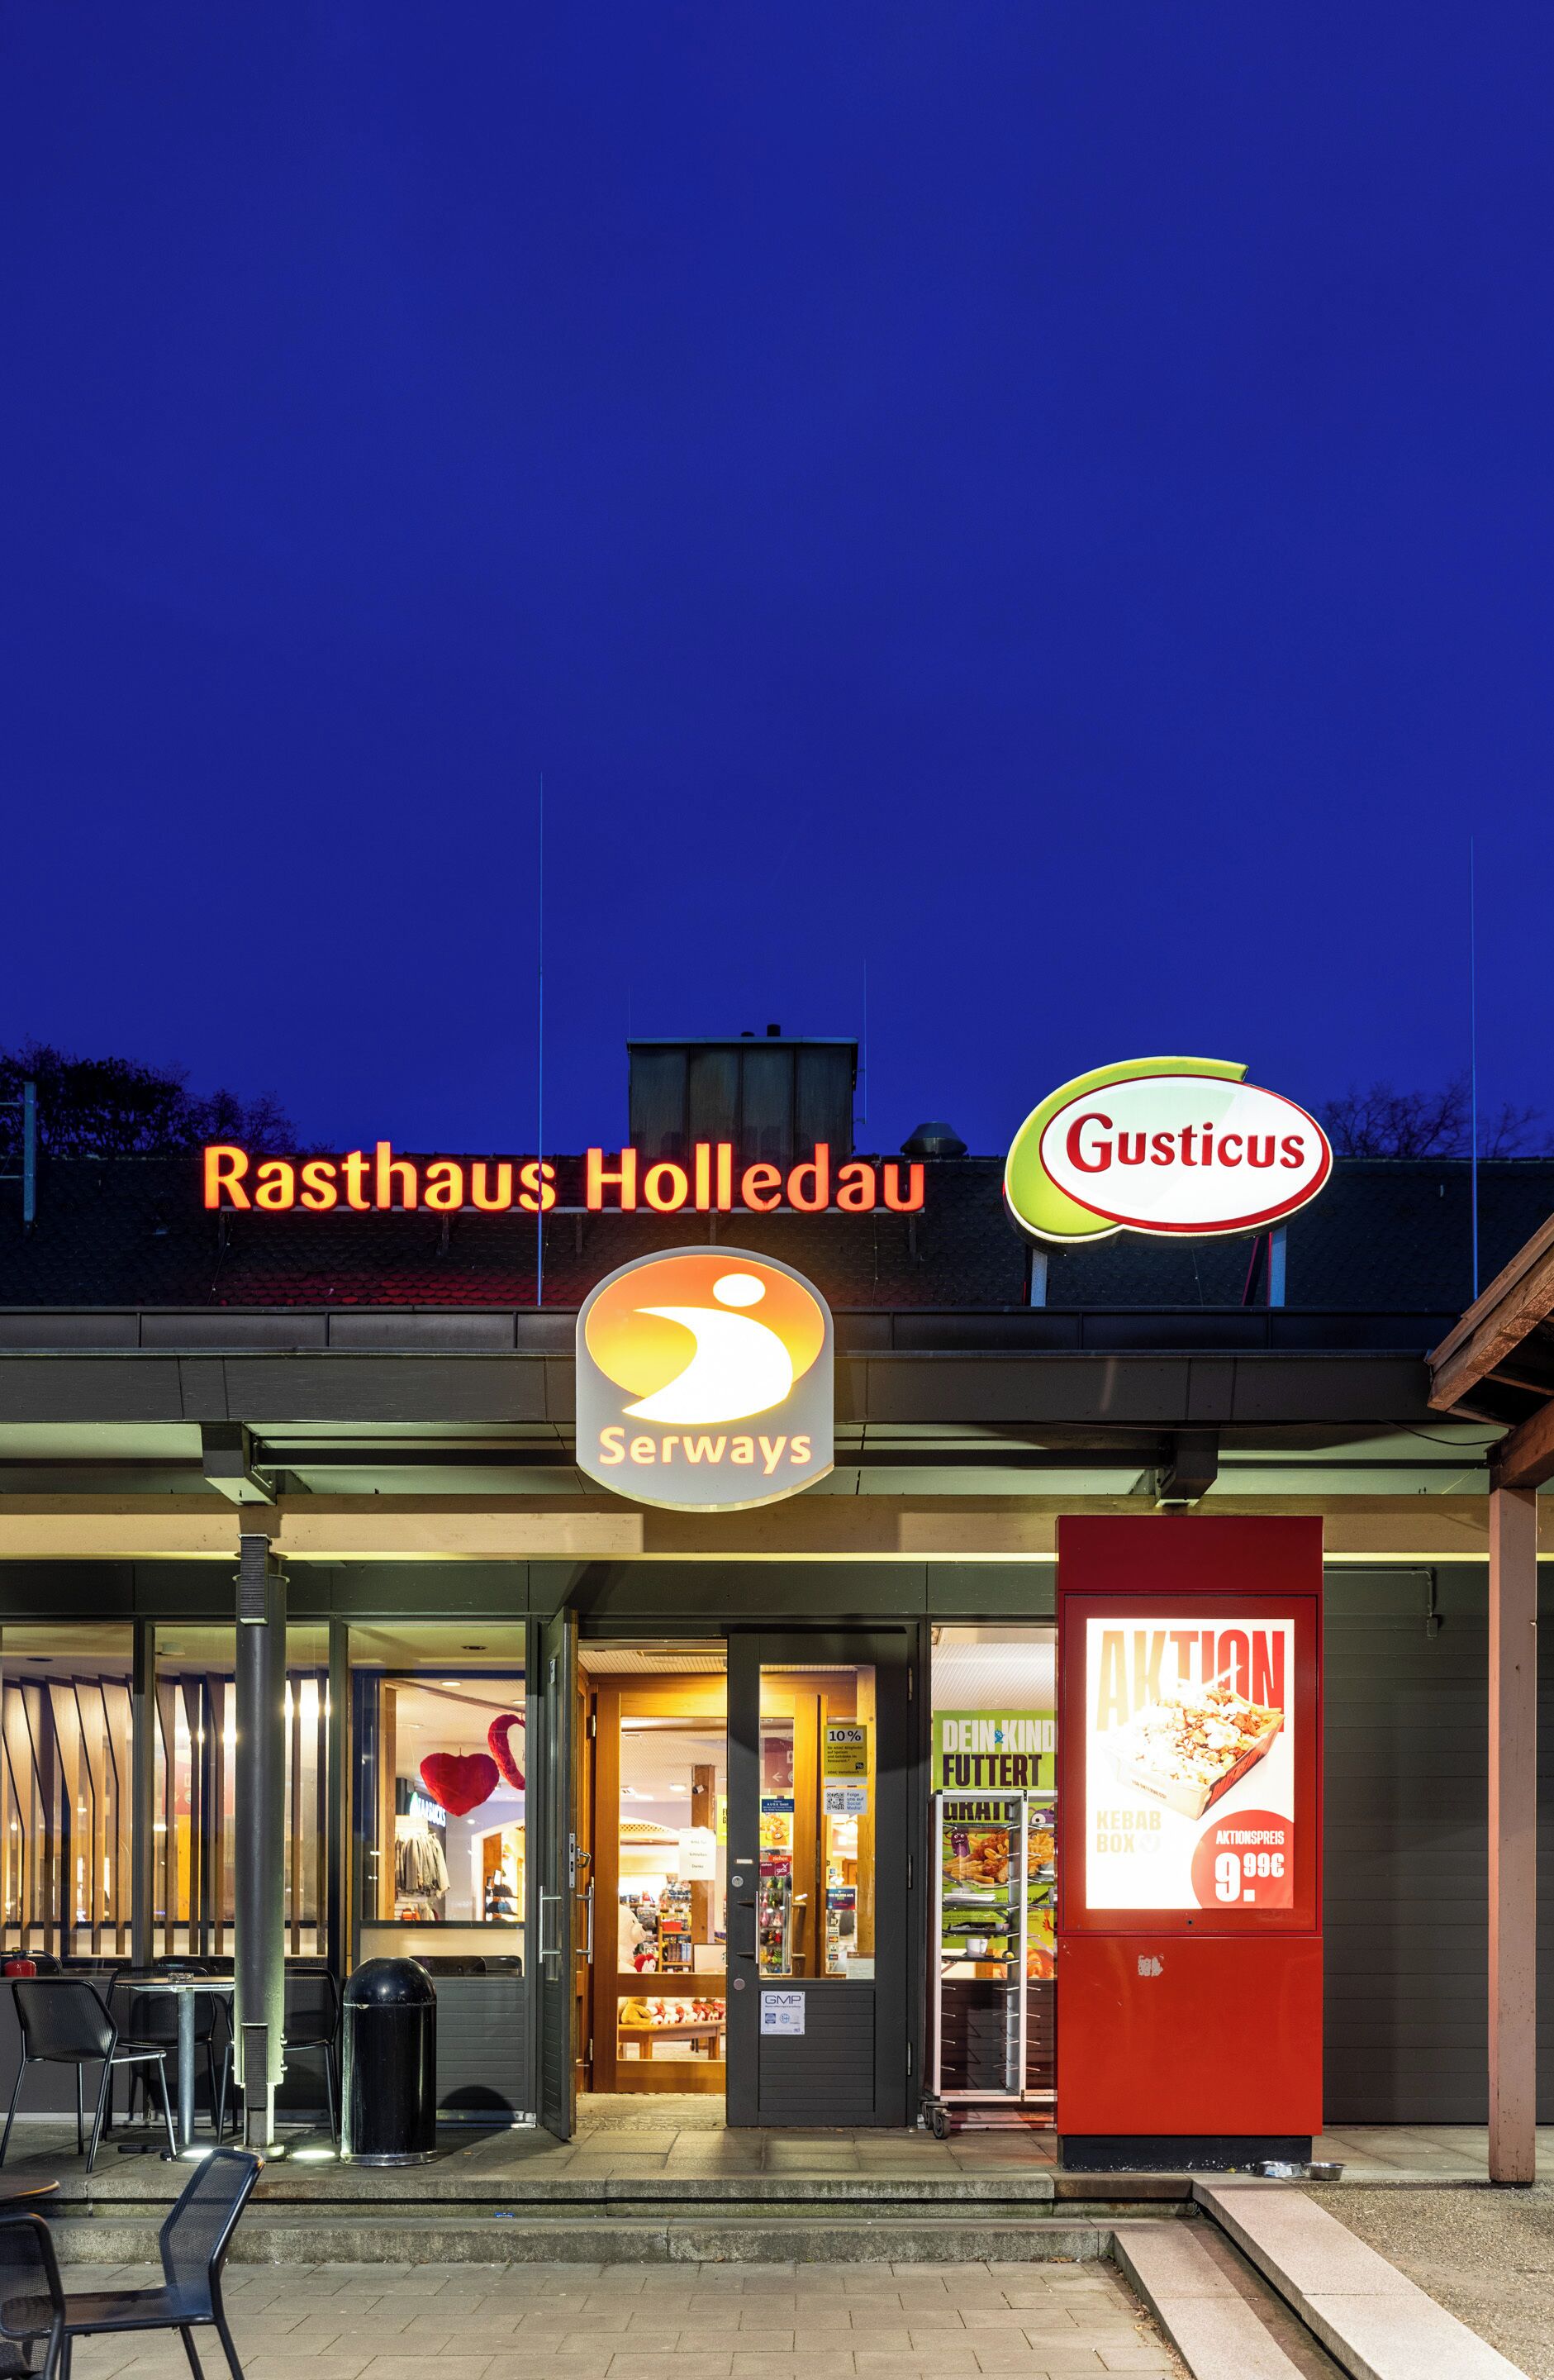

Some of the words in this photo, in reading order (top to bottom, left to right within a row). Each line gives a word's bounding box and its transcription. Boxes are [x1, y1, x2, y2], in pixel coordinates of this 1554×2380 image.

[1066, 1112, 1305, 1173] Gusticus
[203, 1141, 557, 1211] Rasthaus
[586, 1142, 926, 1211] Holledau
[599, 1426, 812, 1476] Serways
[1096, 1630, 1285, 1733] AKTION
[829, 1730, 845, 1741] 10
[848, 1730, 862, 1742] %
[943, 1720, 996, 1752] DEIN
[1001, 1720, 1057, 1752] KIND
[943, 1754, 1043, 1787] FUTTERT
[943, 1788, 1024, 1821] GRATI
[1096, 1810, 1162, 1830] KEBAB
[1096, 1833, 1135, 1853] BOX
[1215, 1830, 1285, 1844] AKTIONSPREIS
[764, 1995, 801, 2004] GMP
